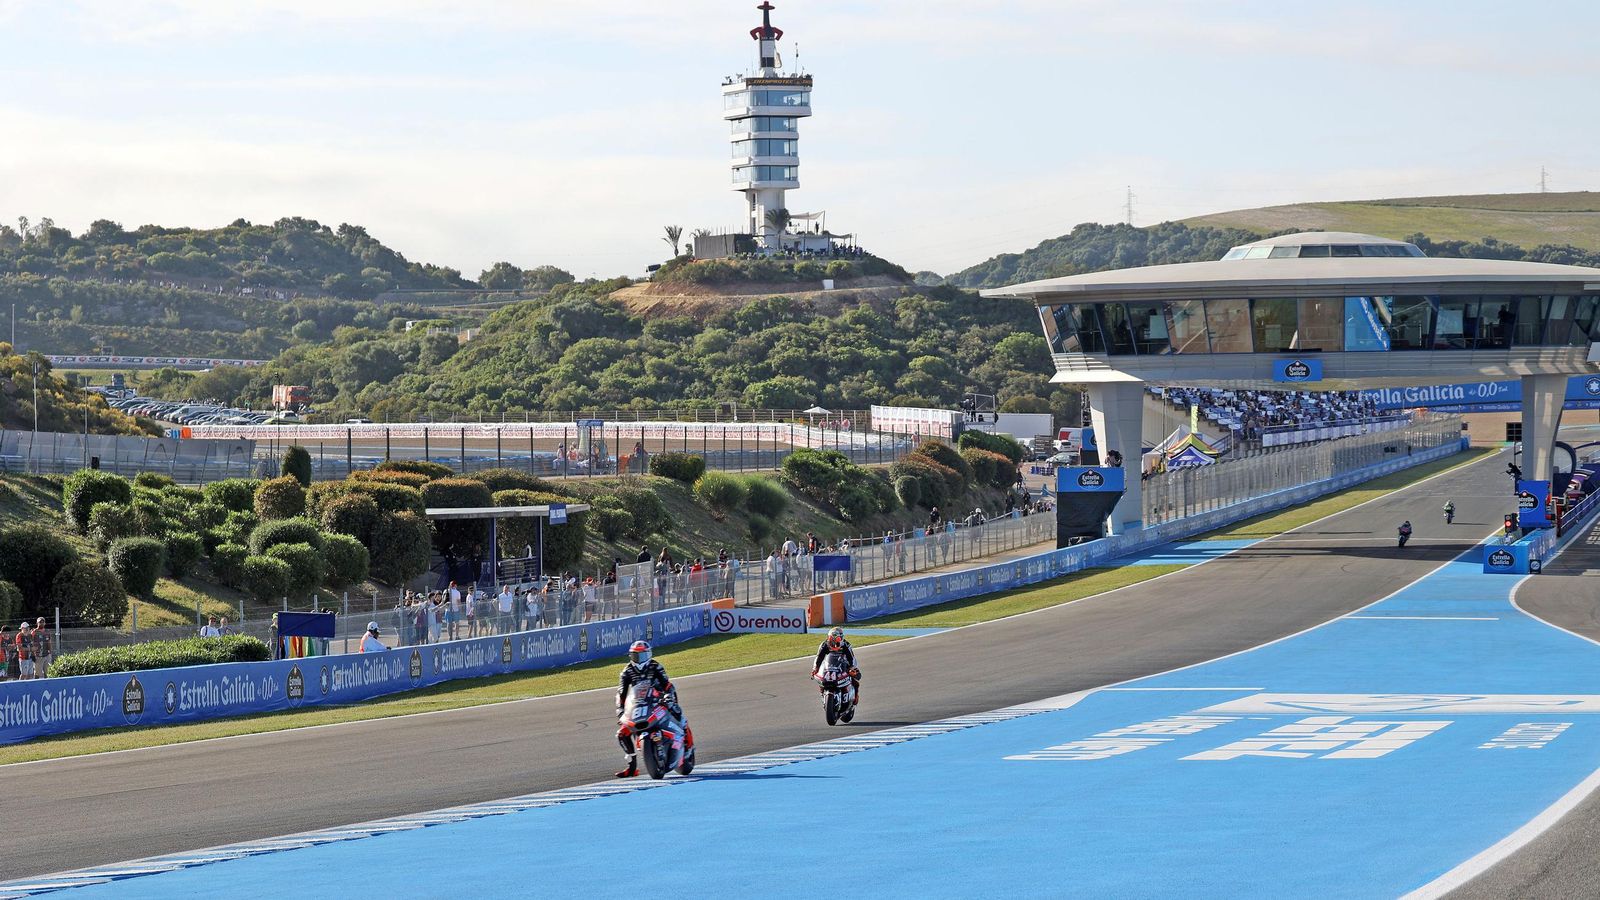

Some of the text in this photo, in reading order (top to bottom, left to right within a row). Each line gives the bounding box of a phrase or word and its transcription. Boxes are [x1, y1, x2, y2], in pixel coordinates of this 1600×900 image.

[1358, 387, 1402, 405] trella
[1405, 384, 1465, 402] Galicia
[1478, 382, 1497, 397] 0,0
[738, 615, 802, 628] brembo
[442, 647, 464, 673] Estrella
[464, 643, 484, 669] Galicia
[526, 637, 546, 659] Estrella
[546, 633, 564, 656] Galicia
[331, 663, 363, 692] Etrella
[362, 658, 388, 686] Galicia
[824, 671, 836, 681] 44
[126, 689, 141, 700] Estrella
[126, 700, 141, 712] Galicia
[179, 675, 273, 711] Estrella Galicia 0,0
[0, 688, 106, 728] strella Galicia 0,0
[1177, 715, 1455, 760] JEREZ
